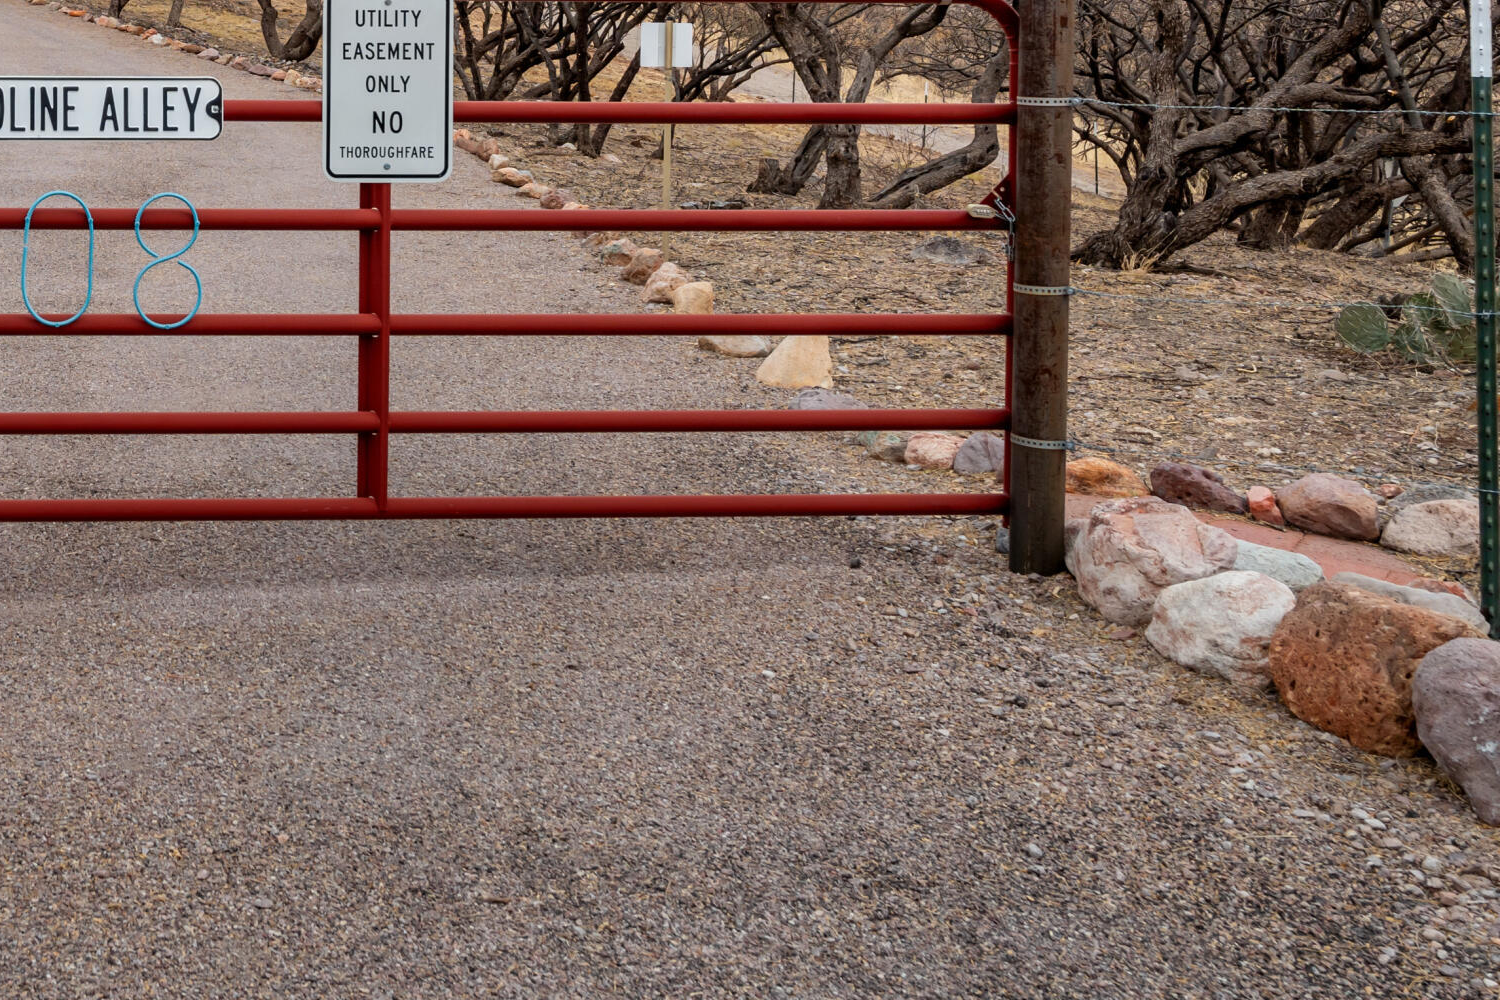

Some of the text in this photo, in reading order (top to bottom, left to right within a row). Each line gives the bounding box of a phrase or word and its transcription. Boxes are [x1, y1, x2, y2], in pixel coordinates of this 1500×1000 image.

[355, 10, 421, 27] UTILITY
[342, 42, 434, 60] EASEMENT
[365, 75, 410, 93] ONLY
[99, 86, 201, 131] ALLEY
[372, 111, 403, 134] NO
[340, 146, 434, 158] THOROUGHFARE
